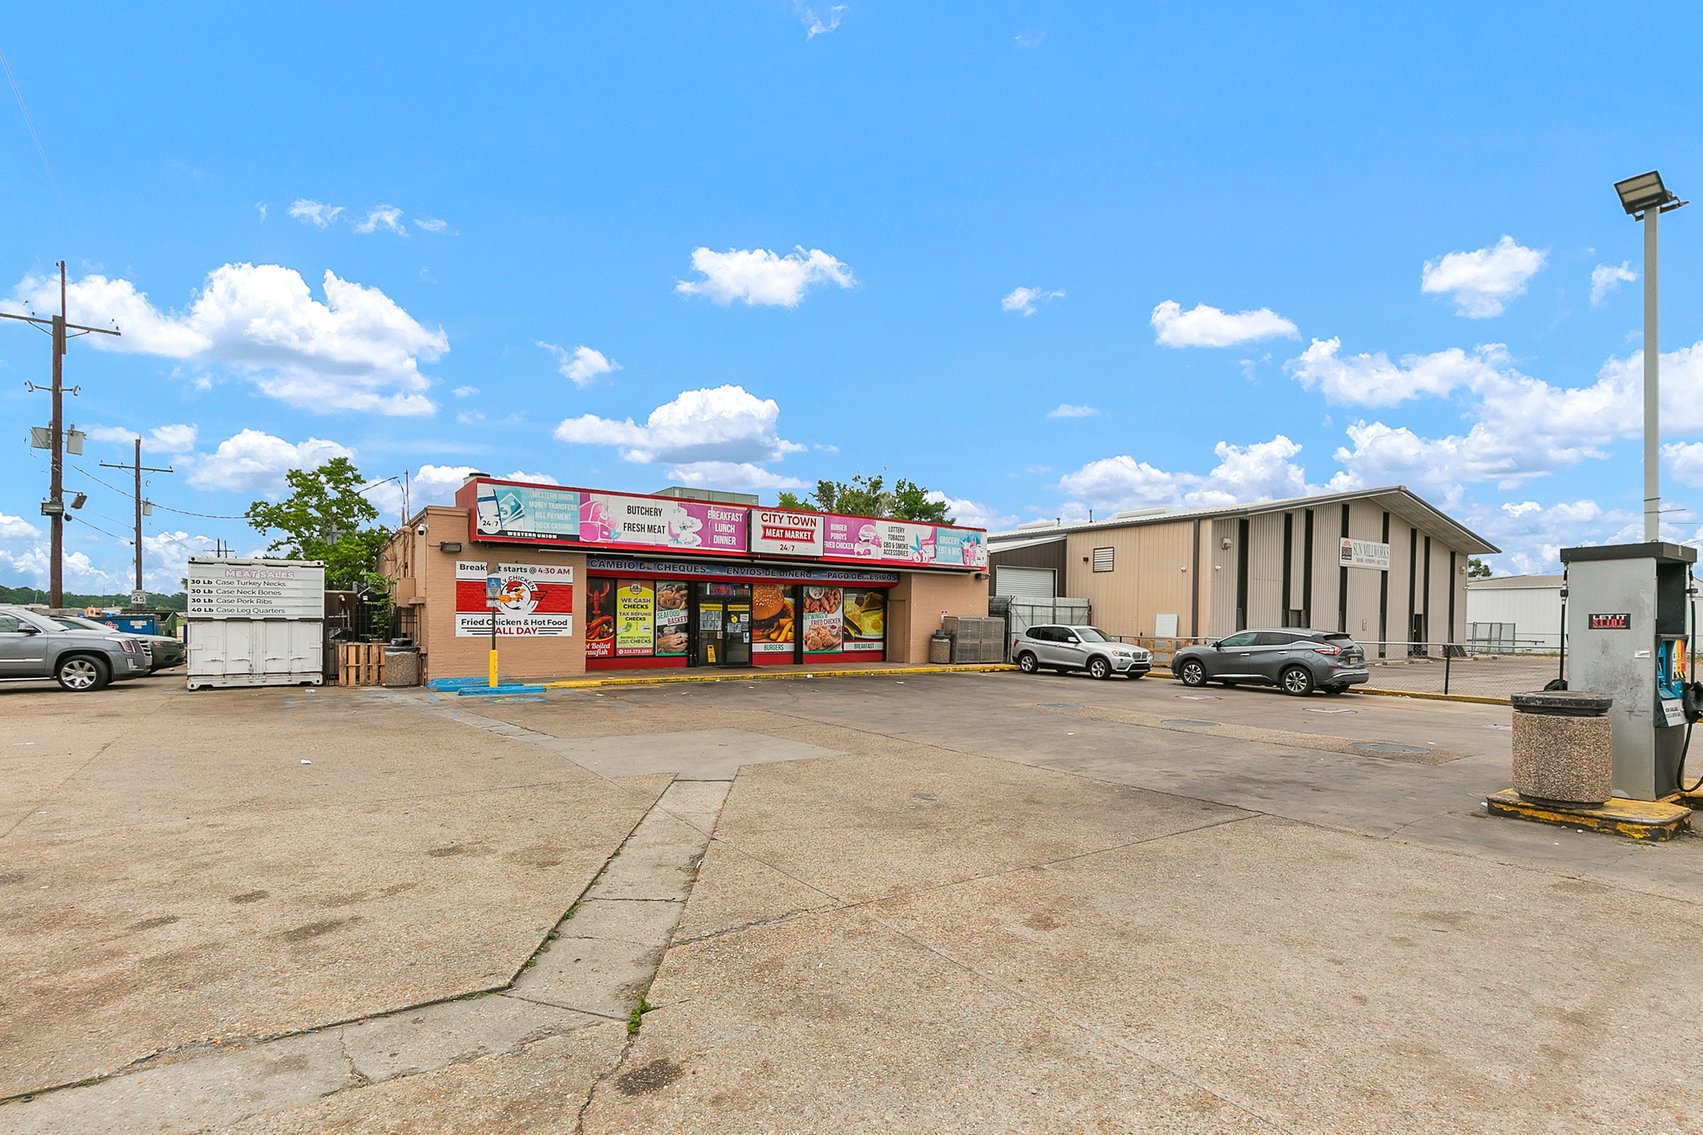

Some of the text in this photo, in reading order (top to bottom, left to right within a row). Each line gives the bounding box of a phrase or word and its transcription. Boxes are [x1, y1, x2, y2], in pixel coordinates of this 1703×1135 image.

[528, 501, 577, 511] MONEY TRANSFERS
[627, 505, 663, 517] BUTCHERY
[535, 511, 571, 520] BILL PAYMENT
[707, 509, 743, 522] BREAKFAST
[761, 512, 817, 527] CITY TOWN
[623, 522, 666, 534] FRESH MEAT
[714, 522, 736, 533] LUNCH
[830, 523, 848, 531] BURGER
[888, 526, 905, 534] LOTTERY
[765, 528, 812, 540] MEAT MARKET
[887, 534, 905, 542] TOBACCO
[713, 535, 736, 545] DINNER
[836, 541, 855, 550] CHICKEN
[895, 542, 909, 550] SMOKE
[883, 549, 909, 557] ACCESSORIES
[459, 563, 501, 572] Breakt
[503, 565, 528, 573] starts
[590, 559, 635, 569] CAMBIO
[656, 563, 706, 574] CHEQUES
[224, 569, 295, 579] MEAT SALES
[726, 567, 812, 578] ENVIOS DE DINERO
[827, 572, 849, 580] PAGO
[236, 580, 262, 588] Turkey
[508, 575, 536, 590] CHICKEN
[657, 610, 680, 620] SEAFOOD
[461, 618, 484, 626] Fried
[494, 627, 538, 635] ALL DAY
[763, 643, 784, 651] BURGERS
[585, 648, 608, 657] rawfish
